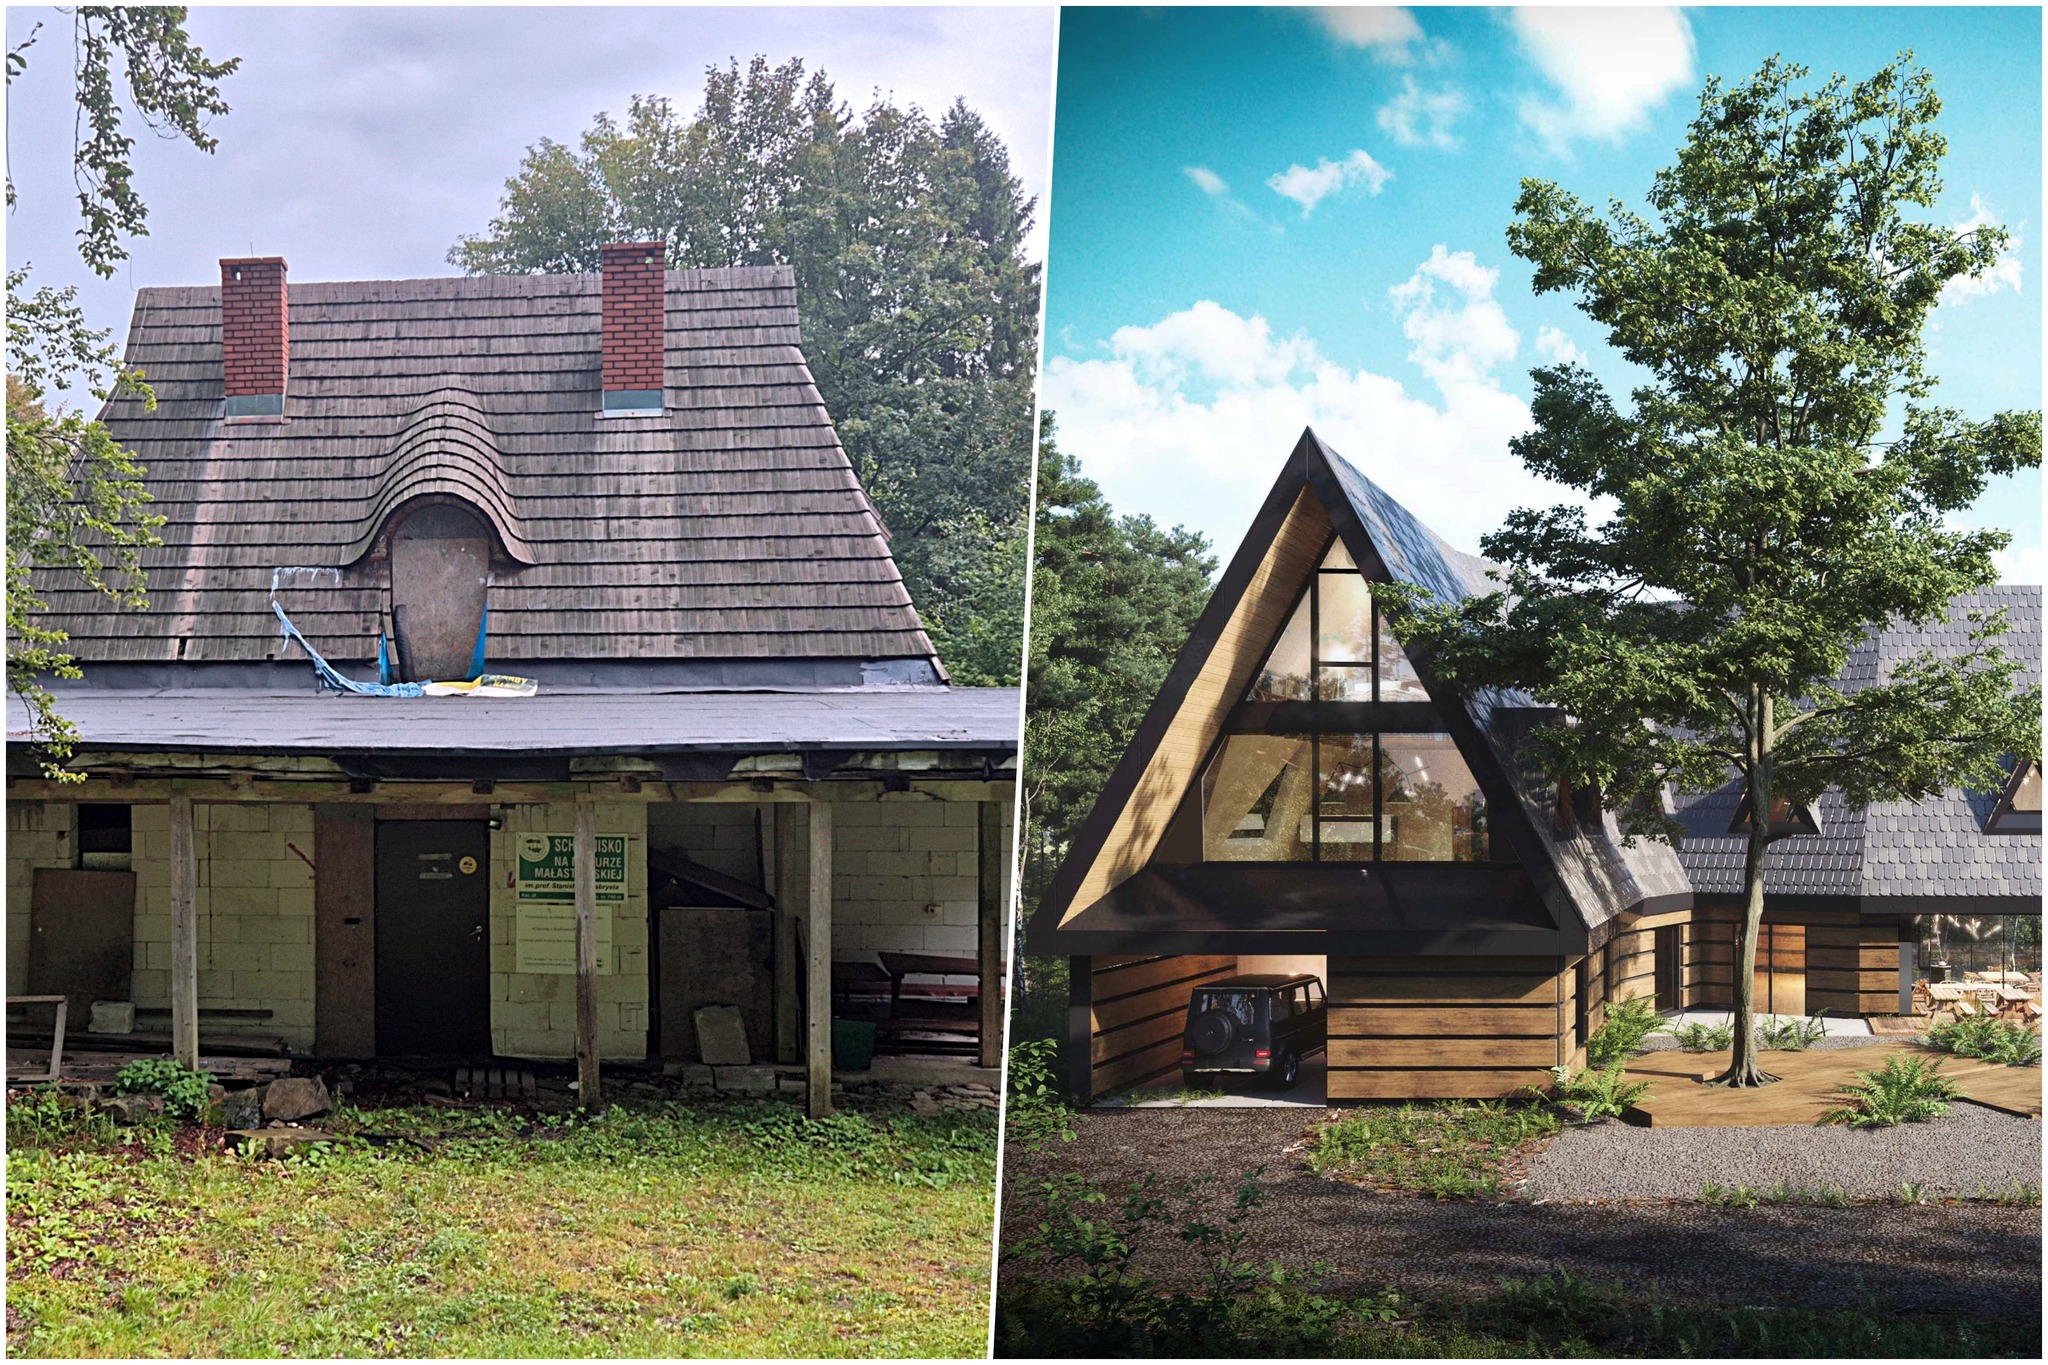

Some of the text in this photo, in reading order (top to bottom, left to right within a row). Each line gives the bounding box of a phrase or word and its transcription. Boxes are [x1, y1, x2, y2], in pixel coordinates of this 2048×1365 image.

[554, 838, 622, 853] SCHISKO
[554, 856, 569, 866] NA
[535, 868, 622, 880] MAŁASTSKIEJ
